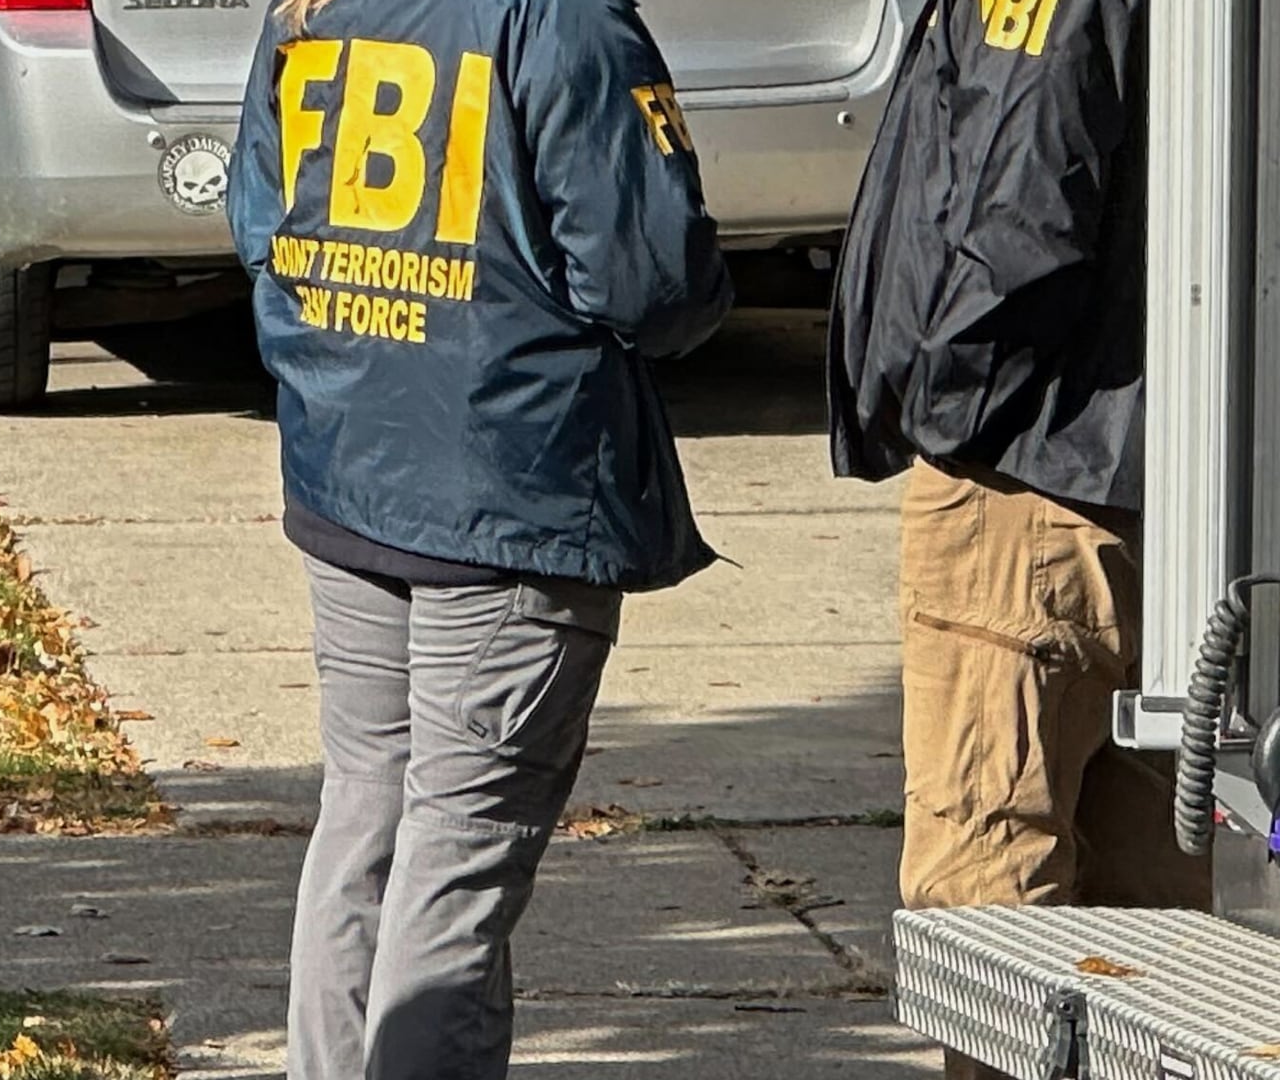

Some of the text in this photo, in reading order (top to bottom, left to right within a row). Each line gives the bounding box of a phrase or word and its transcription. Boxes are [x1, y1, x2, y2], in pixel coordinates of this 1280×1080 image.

[277, 38, 493, 245] FBI
[271, 234, 476, 302] JOINT TERRORISM
[334, 291, 427, 344] FORCE
